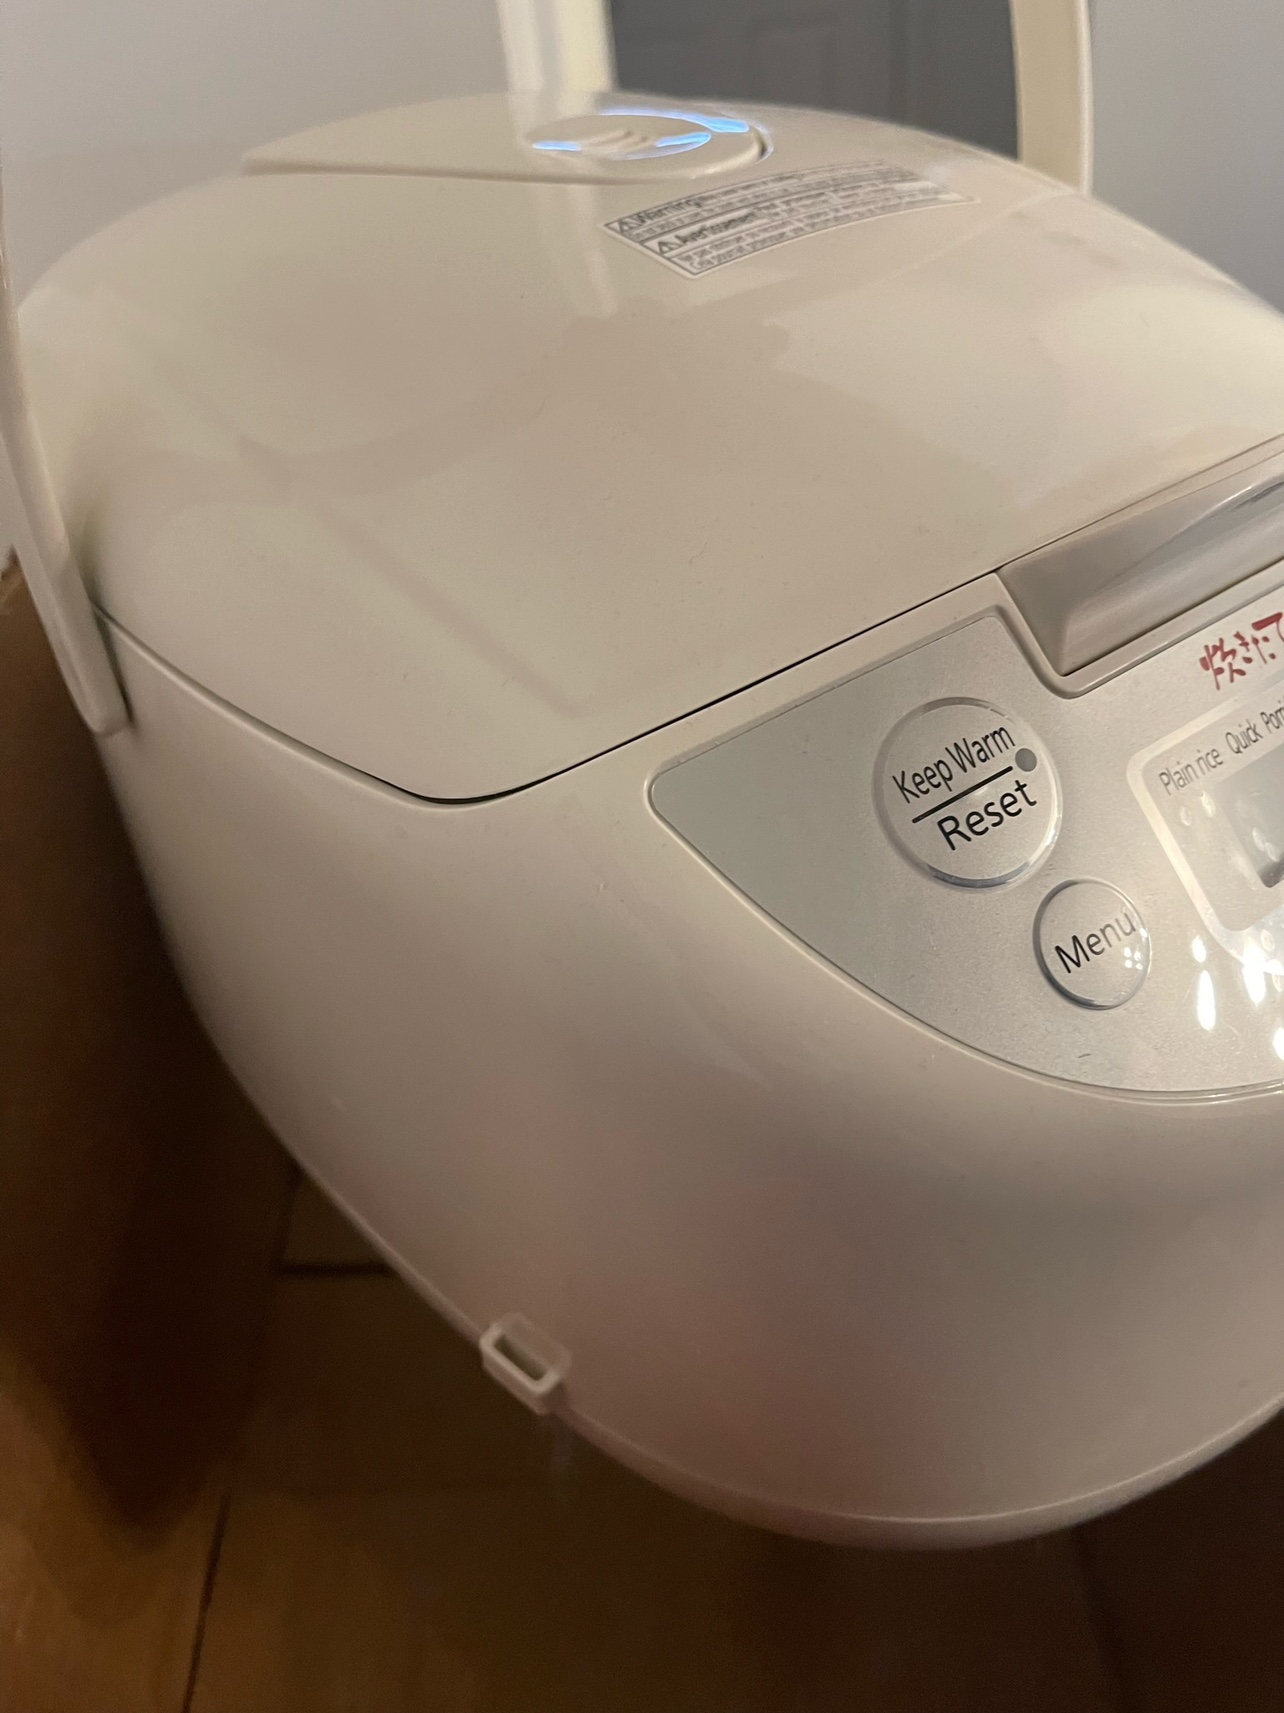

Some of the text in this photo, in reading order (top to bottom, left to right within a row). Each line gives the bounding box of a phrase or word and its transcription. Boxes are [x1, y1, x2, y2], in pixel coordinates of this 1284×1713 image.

[892, 726, 1016, 804] Keep Warm
[1159, 760, 1201, 796] Plain
[1196, 750, 1224, 774] rice
[1225, 718, 1264, 755] Quick
[937, 779, 1038, 851] Reset
[1054, 911, 1136, 975] Menu
